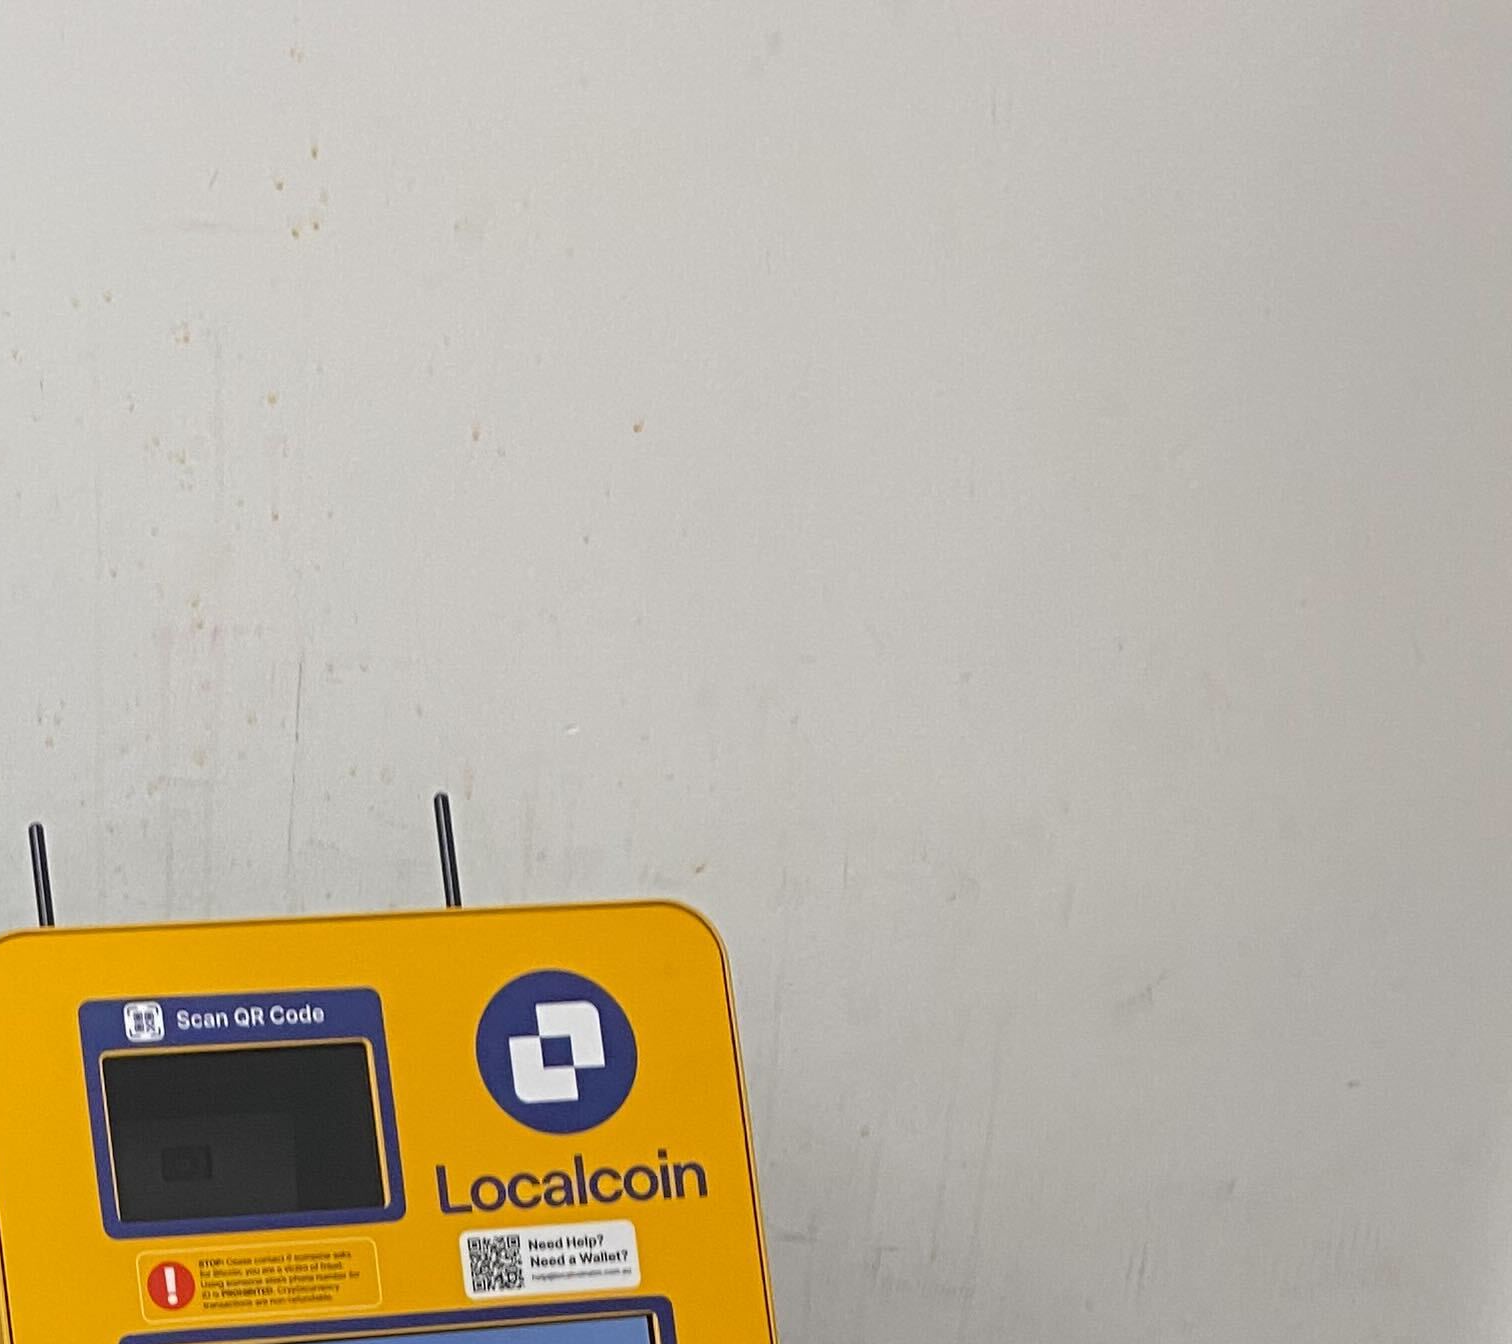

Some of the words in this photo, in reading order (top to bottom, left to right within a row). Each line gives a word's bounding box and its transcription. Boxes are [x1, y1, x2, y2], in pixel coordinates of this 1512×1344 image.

[177, 1009, 228, 1030] Scan
[234, 1006, 264, 1028] QR
[270, 1004, 325, 1025] Code
[436, 1148, 708, 1215] Localcoin
[528, 1237, 563, 1250] Need
[566, 1234, 604, 1249] Help?
[530, 1255, 565, 1267] Need
[569, 1256, 576, 1265] a
[580, 1250, 628, 1264] Wallet?
